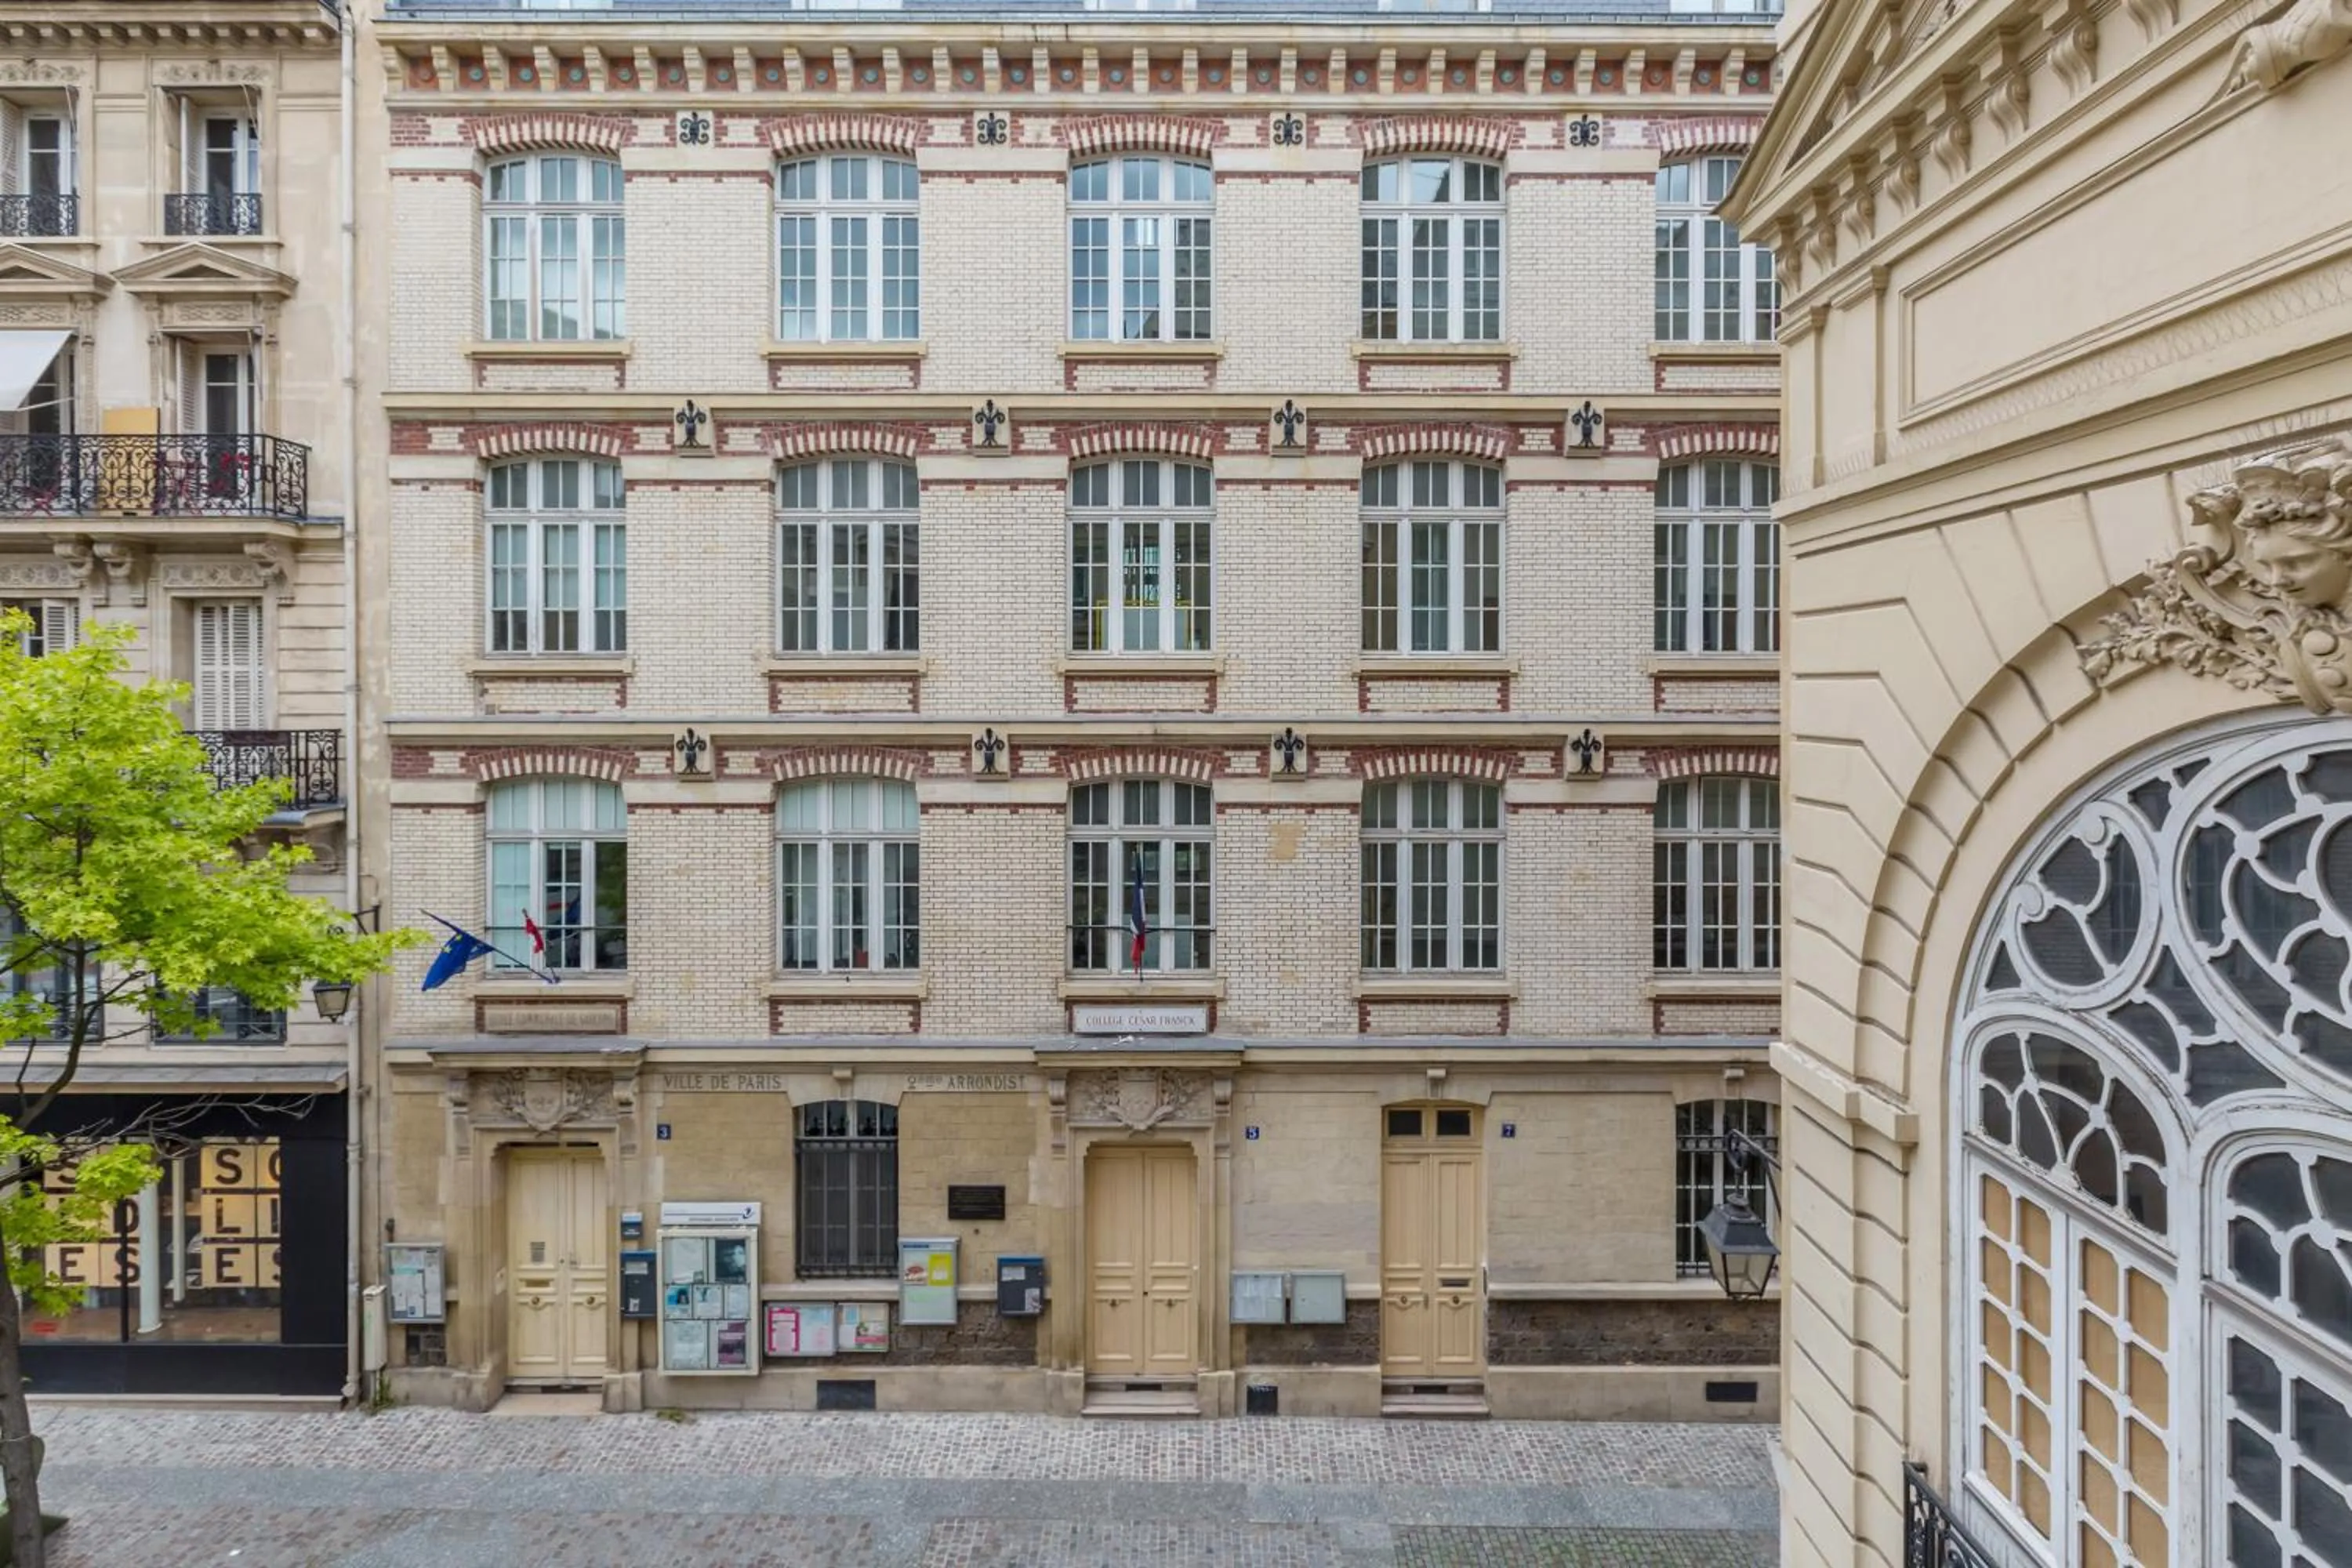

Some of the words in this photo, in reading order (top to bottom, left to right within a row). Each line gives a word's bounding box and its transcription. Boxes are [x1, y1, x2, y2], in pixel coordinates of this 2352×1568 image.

[664, 1075, 702, 1089] VILLE
[710, 1075, 730, 1090] DE
[738, 1075, 782, 1089] PARIS
